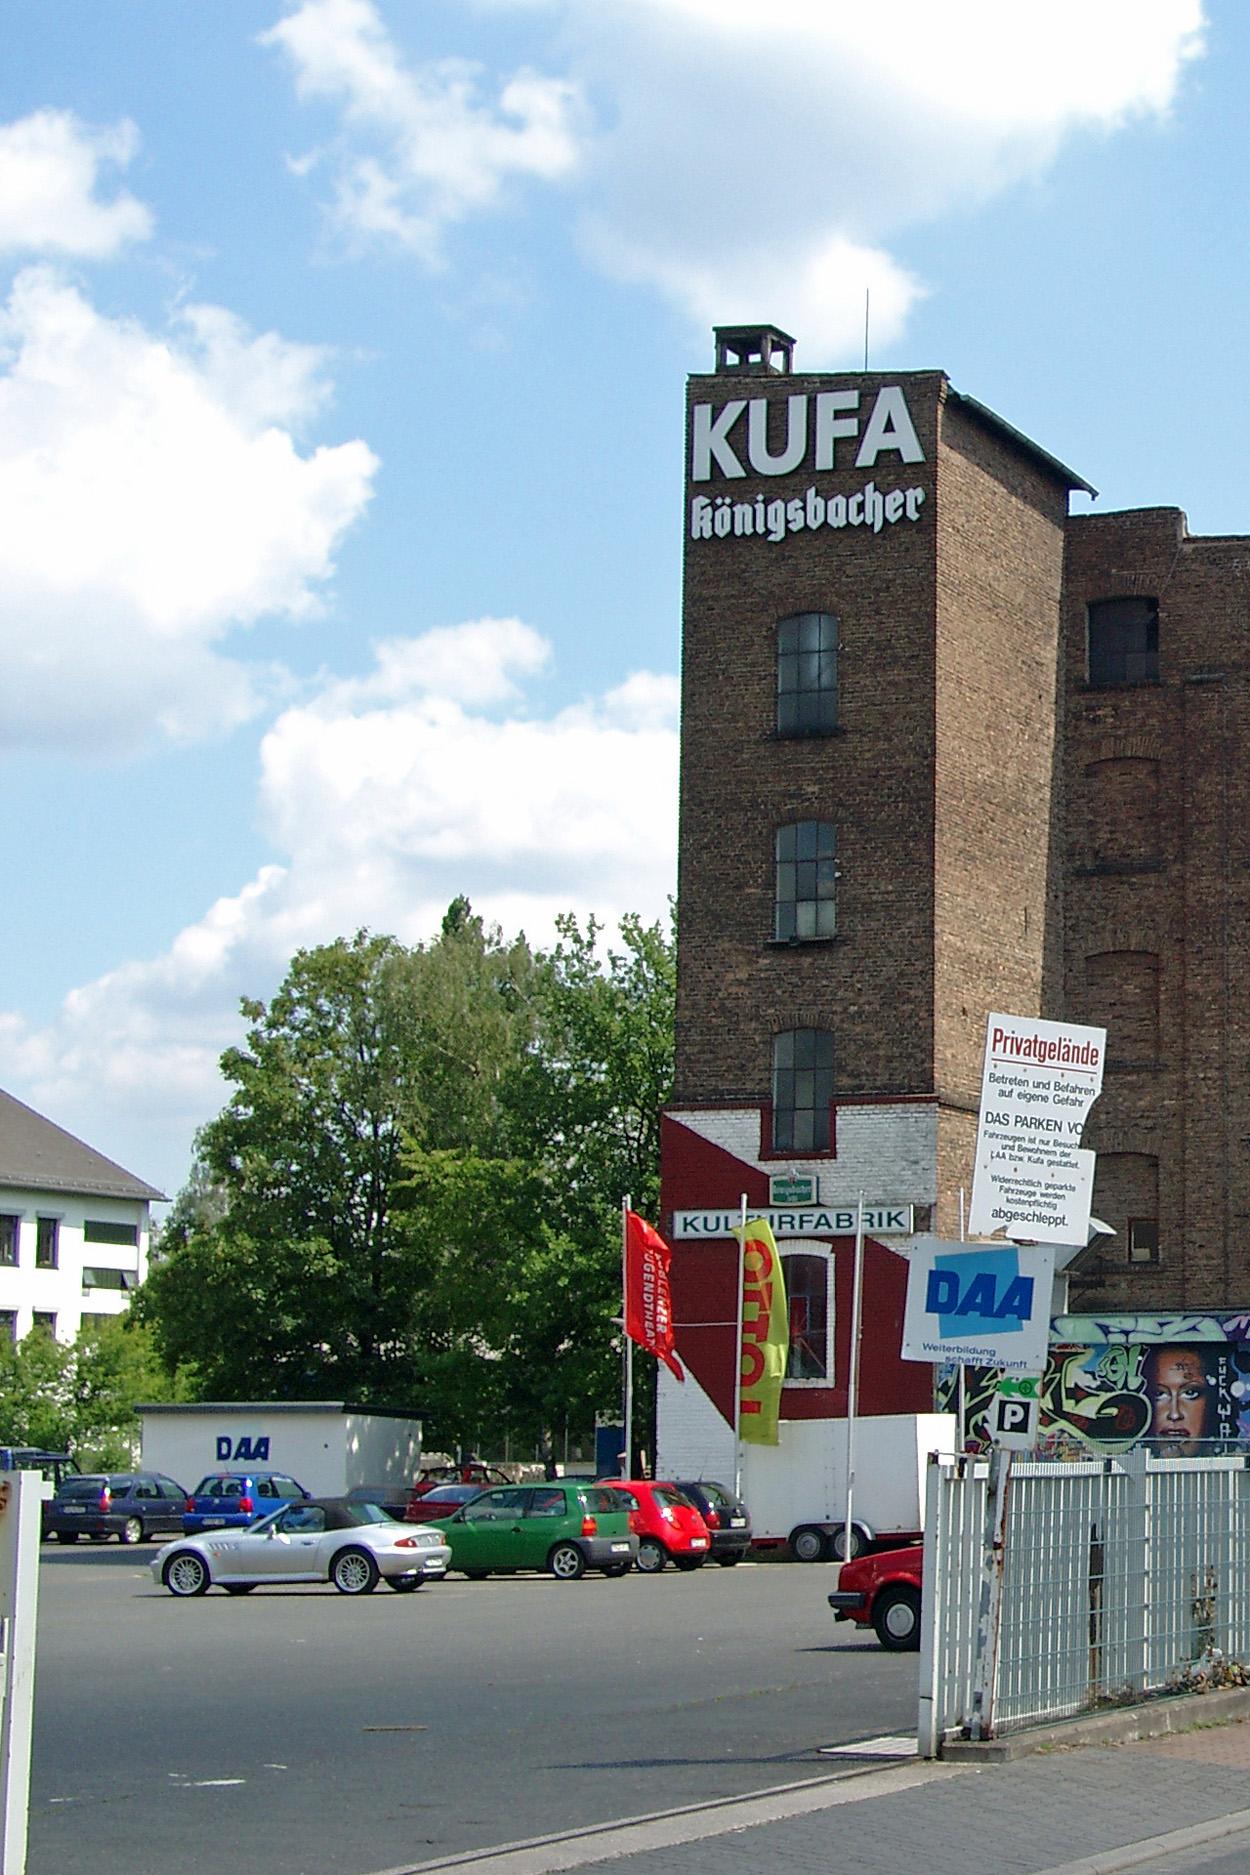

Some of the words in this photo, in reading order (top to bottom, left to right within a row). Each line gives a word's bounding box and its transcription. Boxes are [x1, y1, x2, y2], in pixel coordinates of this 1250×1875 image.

[691, 385, 927, 482] KUFA
[992, 1028, 1099, 1066] Privatgelände
[988, 1072, 1029, 1087] Betreten
[1032, 1080, 1051, 1090] und
[1054, 1081, 1096, 1096] Befahren
[998, 1088, 1014, 1098] auf
[1017, 1090, 1049, 1103] eigene
[1053, 1094, 1084, 1107] Gefahr
[985, 1111, 1010, 1126] DAS
[1014, 1115, 1063, 1133] PARKEN
[984, 1130, 1026, 1143] Fahrzeugen
[1028, 1136, 1037, 1145] ist
[1040, 1138, 1051, 1146] nur
[1001, 1143, 1016, 1152] und
[1060, 1150, 1072, 1158] der
[1027, 1156, 1045, 1165] Kufa
[990, 1174, 1042, 1188] Widerrechtlich
[999, 1185, 1037, 1198] Fahrzeuge
[1039, 1191, 1066, 1200] werden
[991, 1207, 1068, 1228] abgeschleppt.
[925, 1269, 1035, 1321] DAA
[922, 1342, 997, 1357] Weiterbildung
[945, 1355, 983, 1365] schafft
[985, 1357, 1028, 1369] Zukunft
[1003, 1403, 1025, 1430] P
[216, 1435, 270, 1460] DAA
